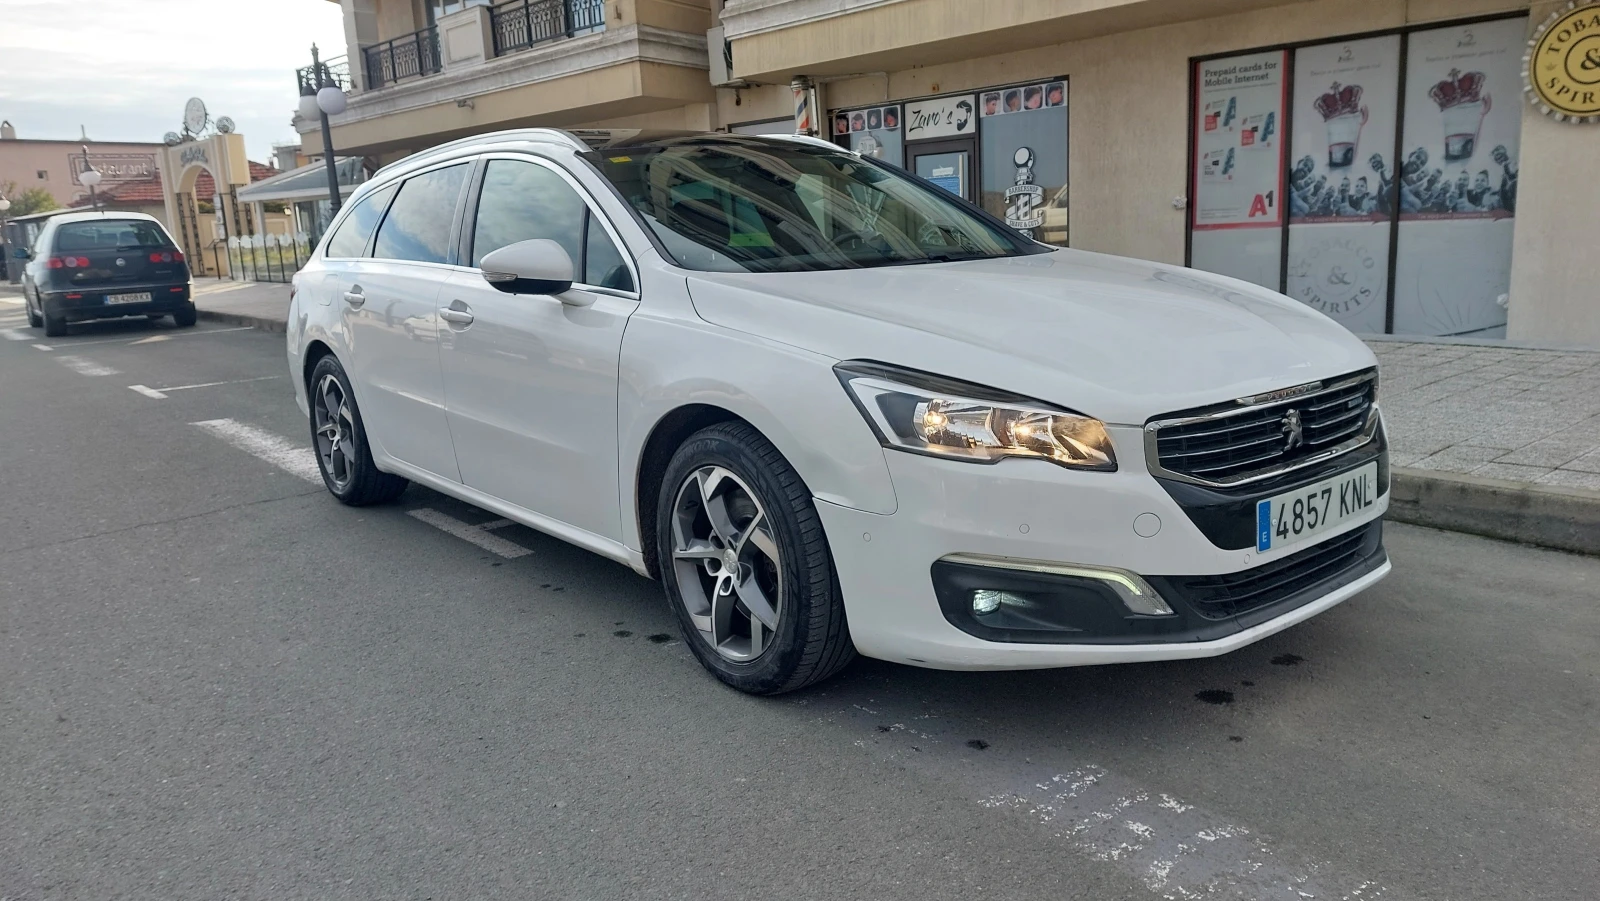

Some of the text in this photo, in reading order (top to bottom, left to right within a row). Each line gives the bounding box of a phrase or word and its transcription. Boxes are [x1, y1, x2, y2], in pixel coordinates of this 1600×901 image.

[1580, 47, 1600, 71] &
[1204, 61, 1278, 78] Prepaid cards for
[1204, 73, 1269, 87] Mobile Internet
[1008, 185, 1039, 195] BARBERSHOP
[1248, 190, 1274, 218] A1
[1009, 220, 1023, 228] SHAVE
[1028, 220, 1040, 228] CUTS
[1327, 265, 1351, 286] &
[1302, 286, 1372, 314] SPIRITS
[1276, 473, 1373, 540] 4857 KNL
[1262, 531, 1268, 543] E
